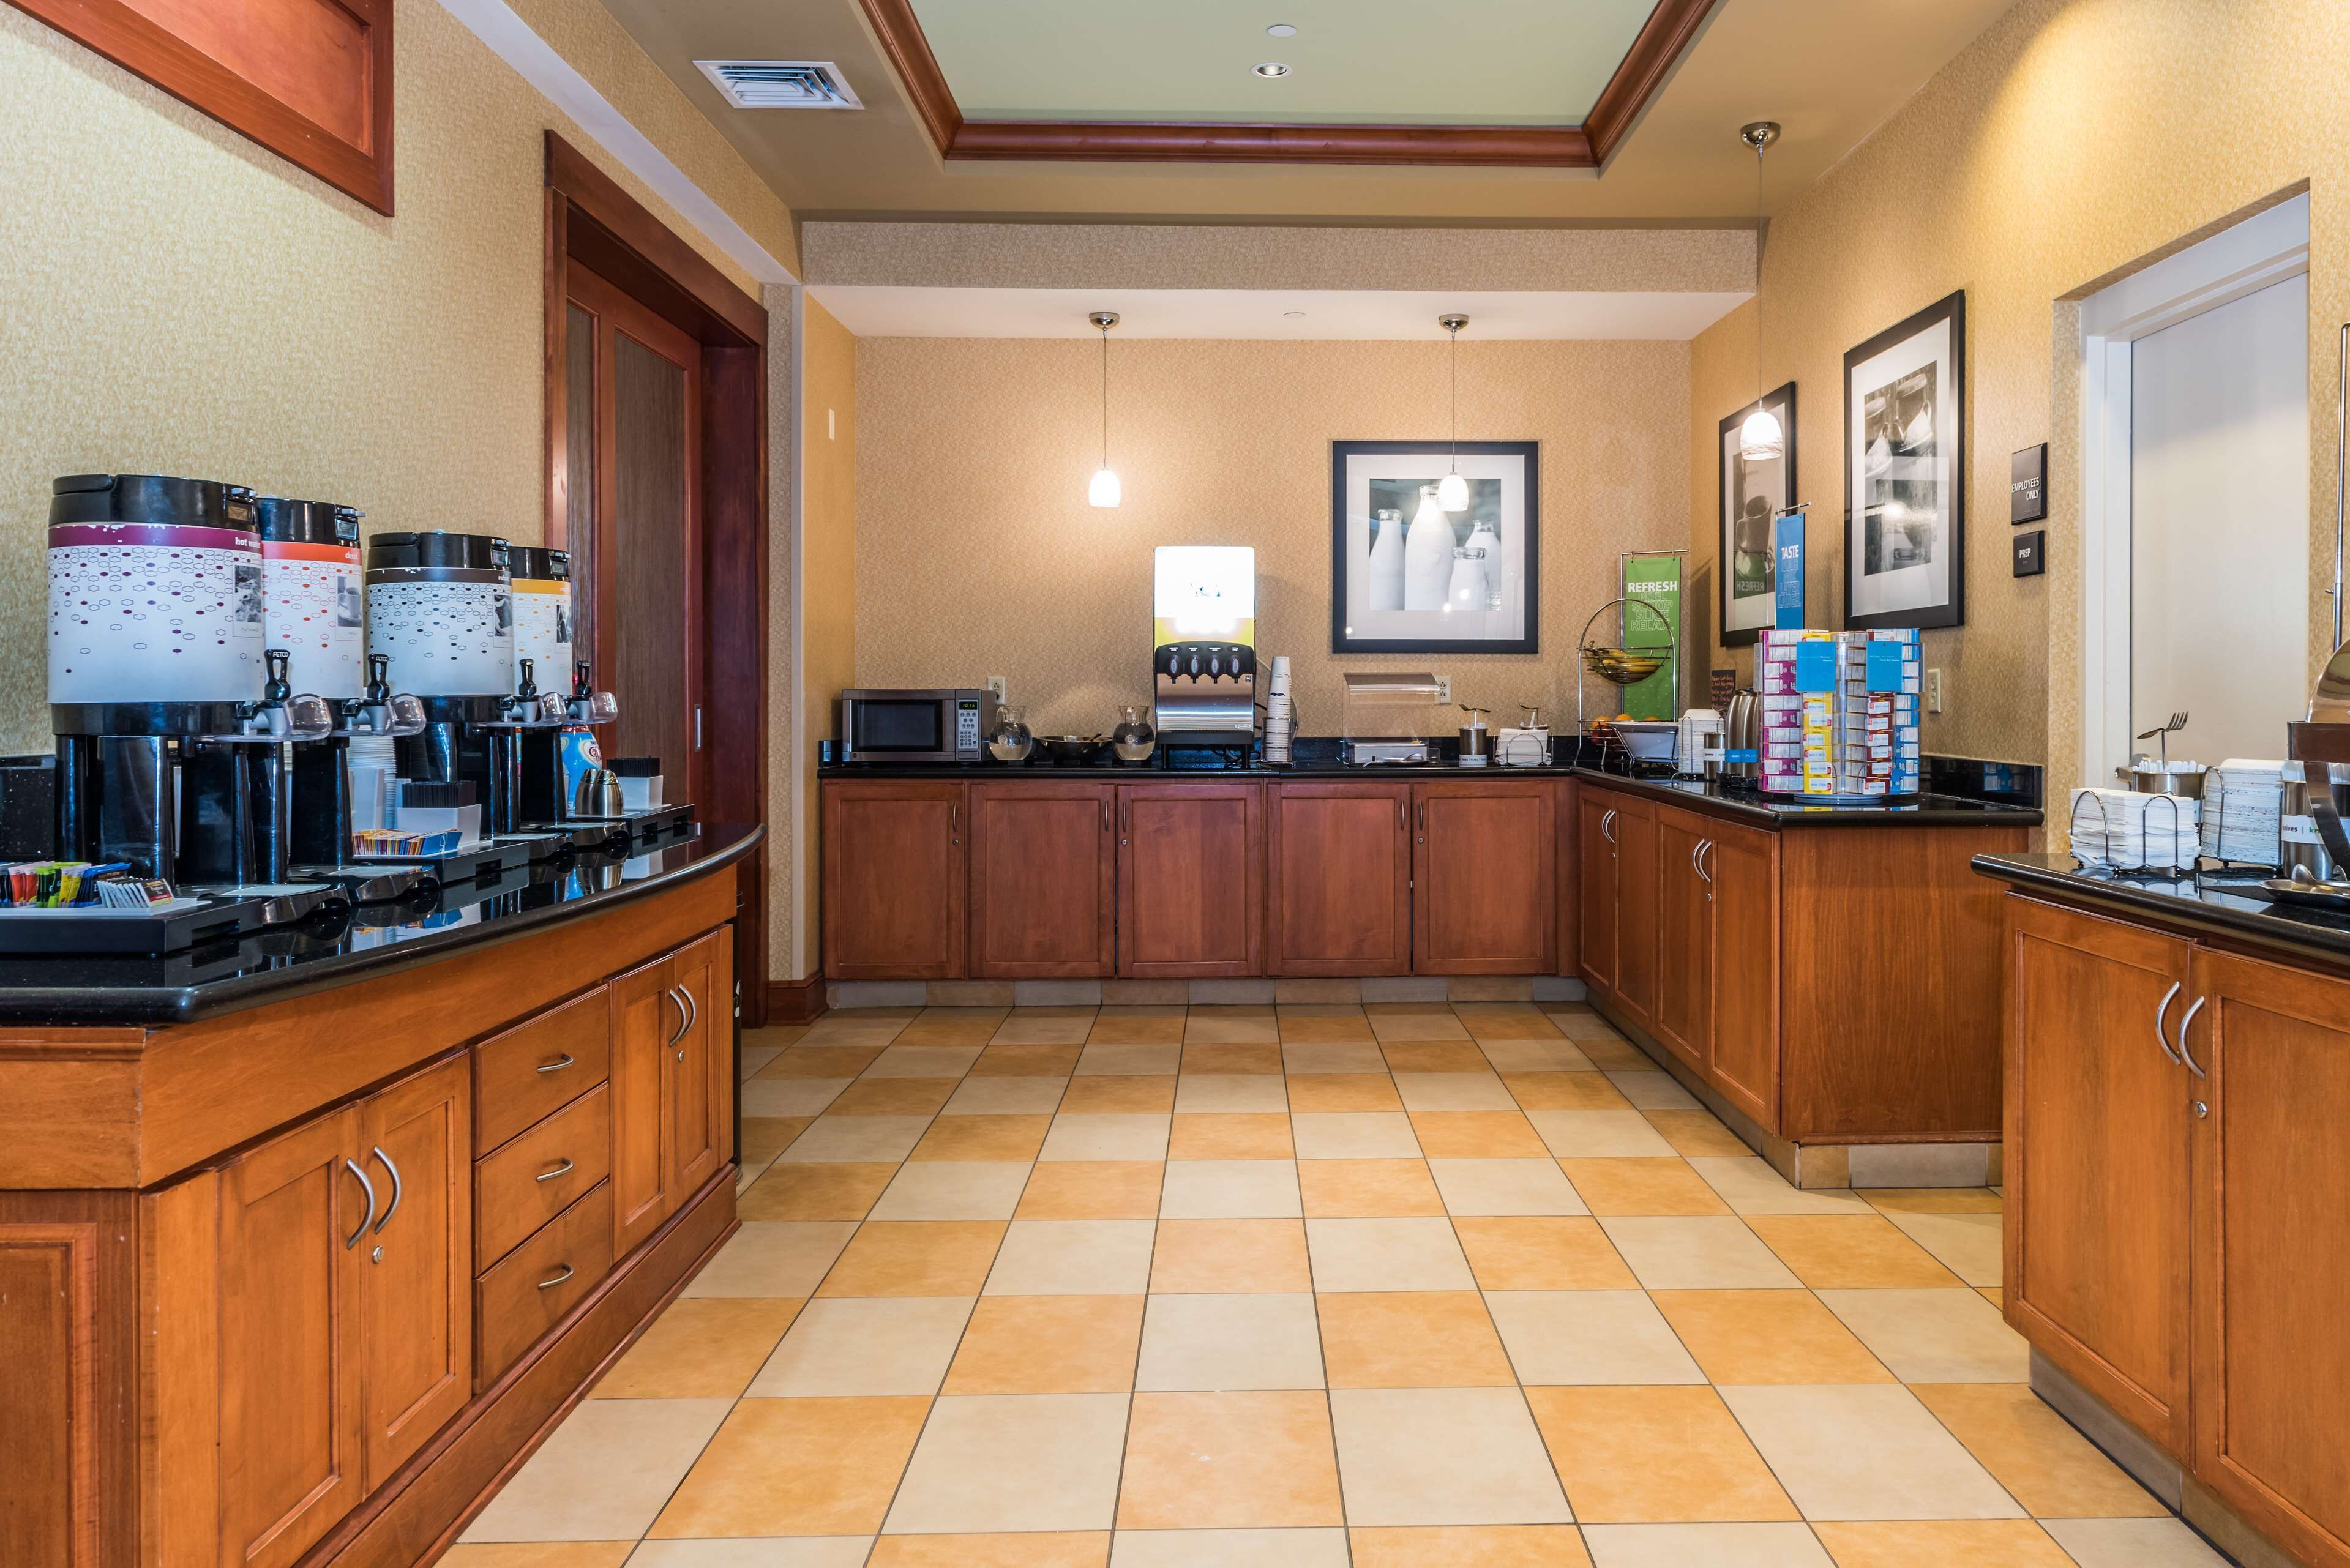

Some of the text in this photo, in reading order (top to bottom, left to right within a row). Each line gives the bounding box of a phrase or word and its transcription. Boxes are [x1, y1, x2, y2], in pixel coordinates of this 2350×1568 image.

[2011, 476, 2040, 493] EMPLOYEES
[2026, 489, 2040, 501] ONLY
[234, 536, 249, 547] hot
[1781, 544, 1800, 559] TASTE
[2018, 547, 2032, 559] PREP
[1628, 581, 1678, 593] REFRESH
[1638, 592, 1667, 601] PEEL
[1631, 600, 1674, 612] SCOOP
[1635, 610, 1670, 621] SLICE
[1630, 619, 1675, 632] RELAX.
